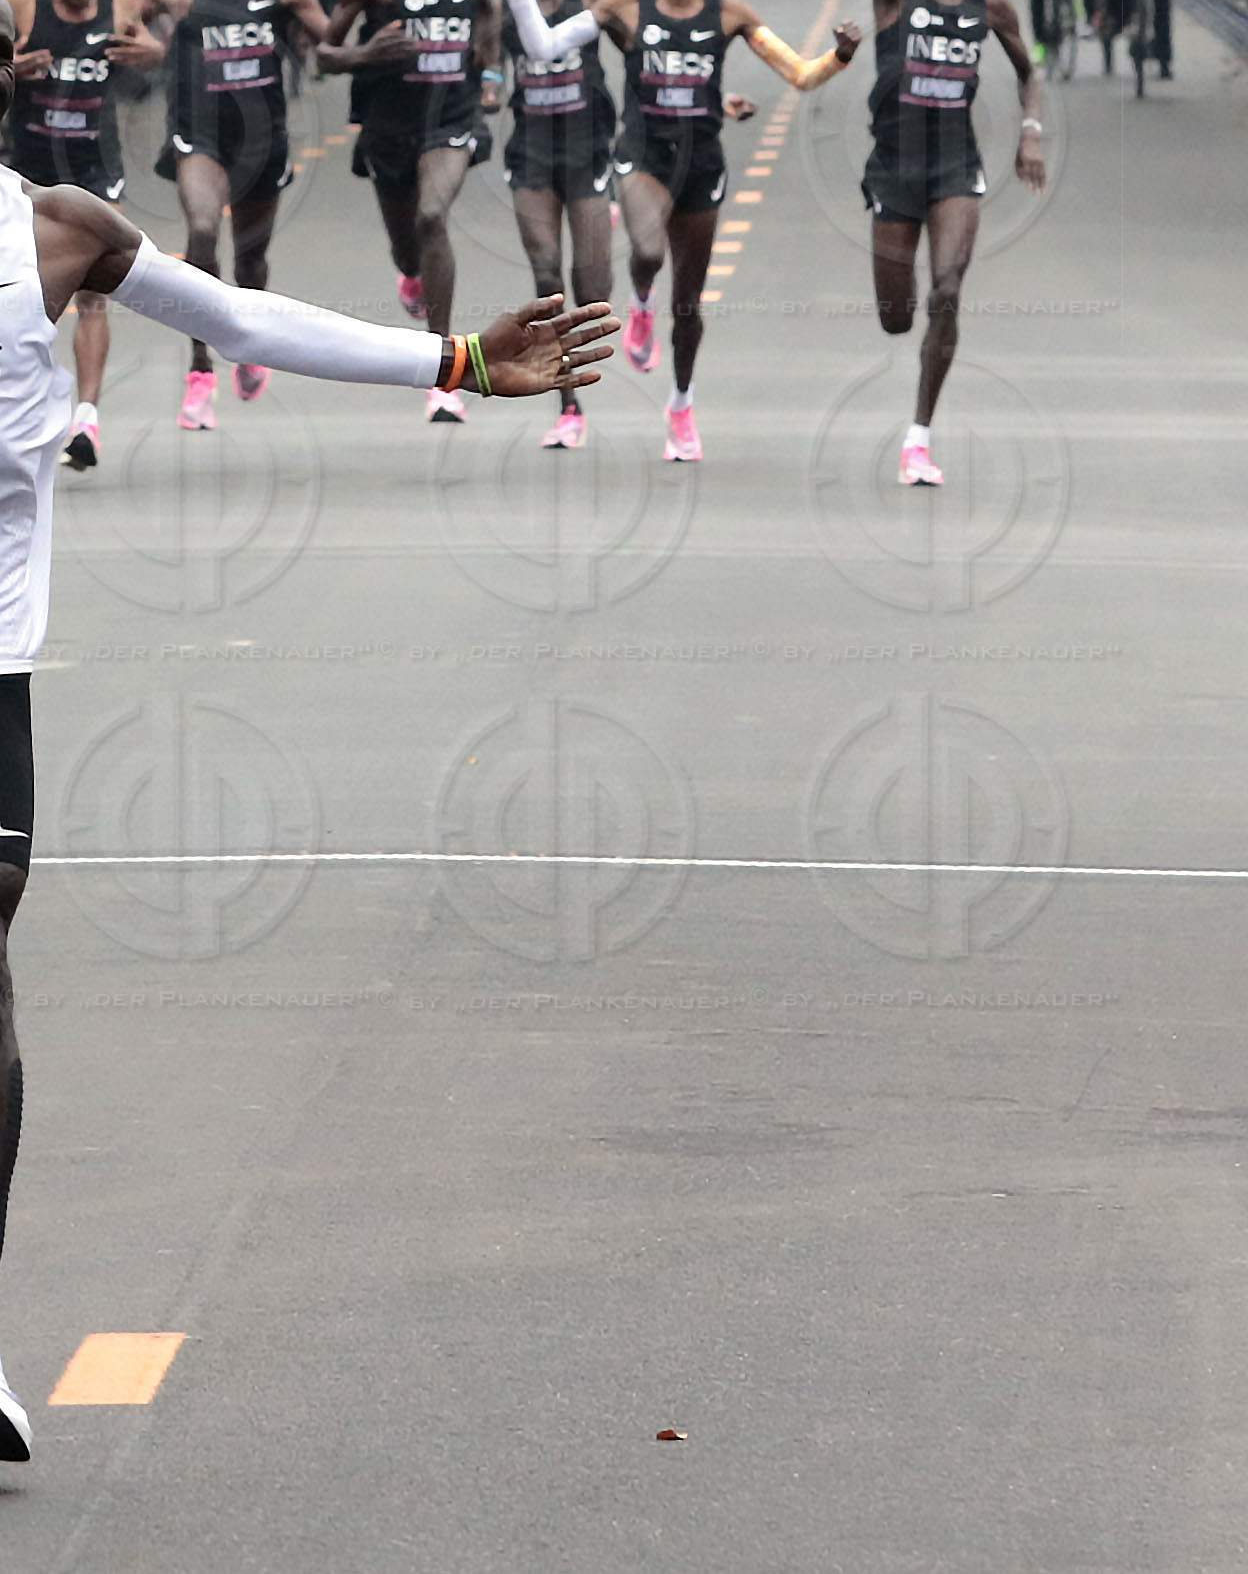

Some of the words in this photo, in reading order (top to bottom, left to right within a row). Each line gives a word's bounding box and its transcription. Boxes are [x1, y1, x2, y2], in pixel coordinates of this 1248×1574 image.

[202, 22, 275, 51] INEOS
[405, 17, 472, 42] INEOS
[906, 33, 980, 65] INEOS
[48, 57, 109, 82] NEOS
[642, 50, 715, 78] INEOS
